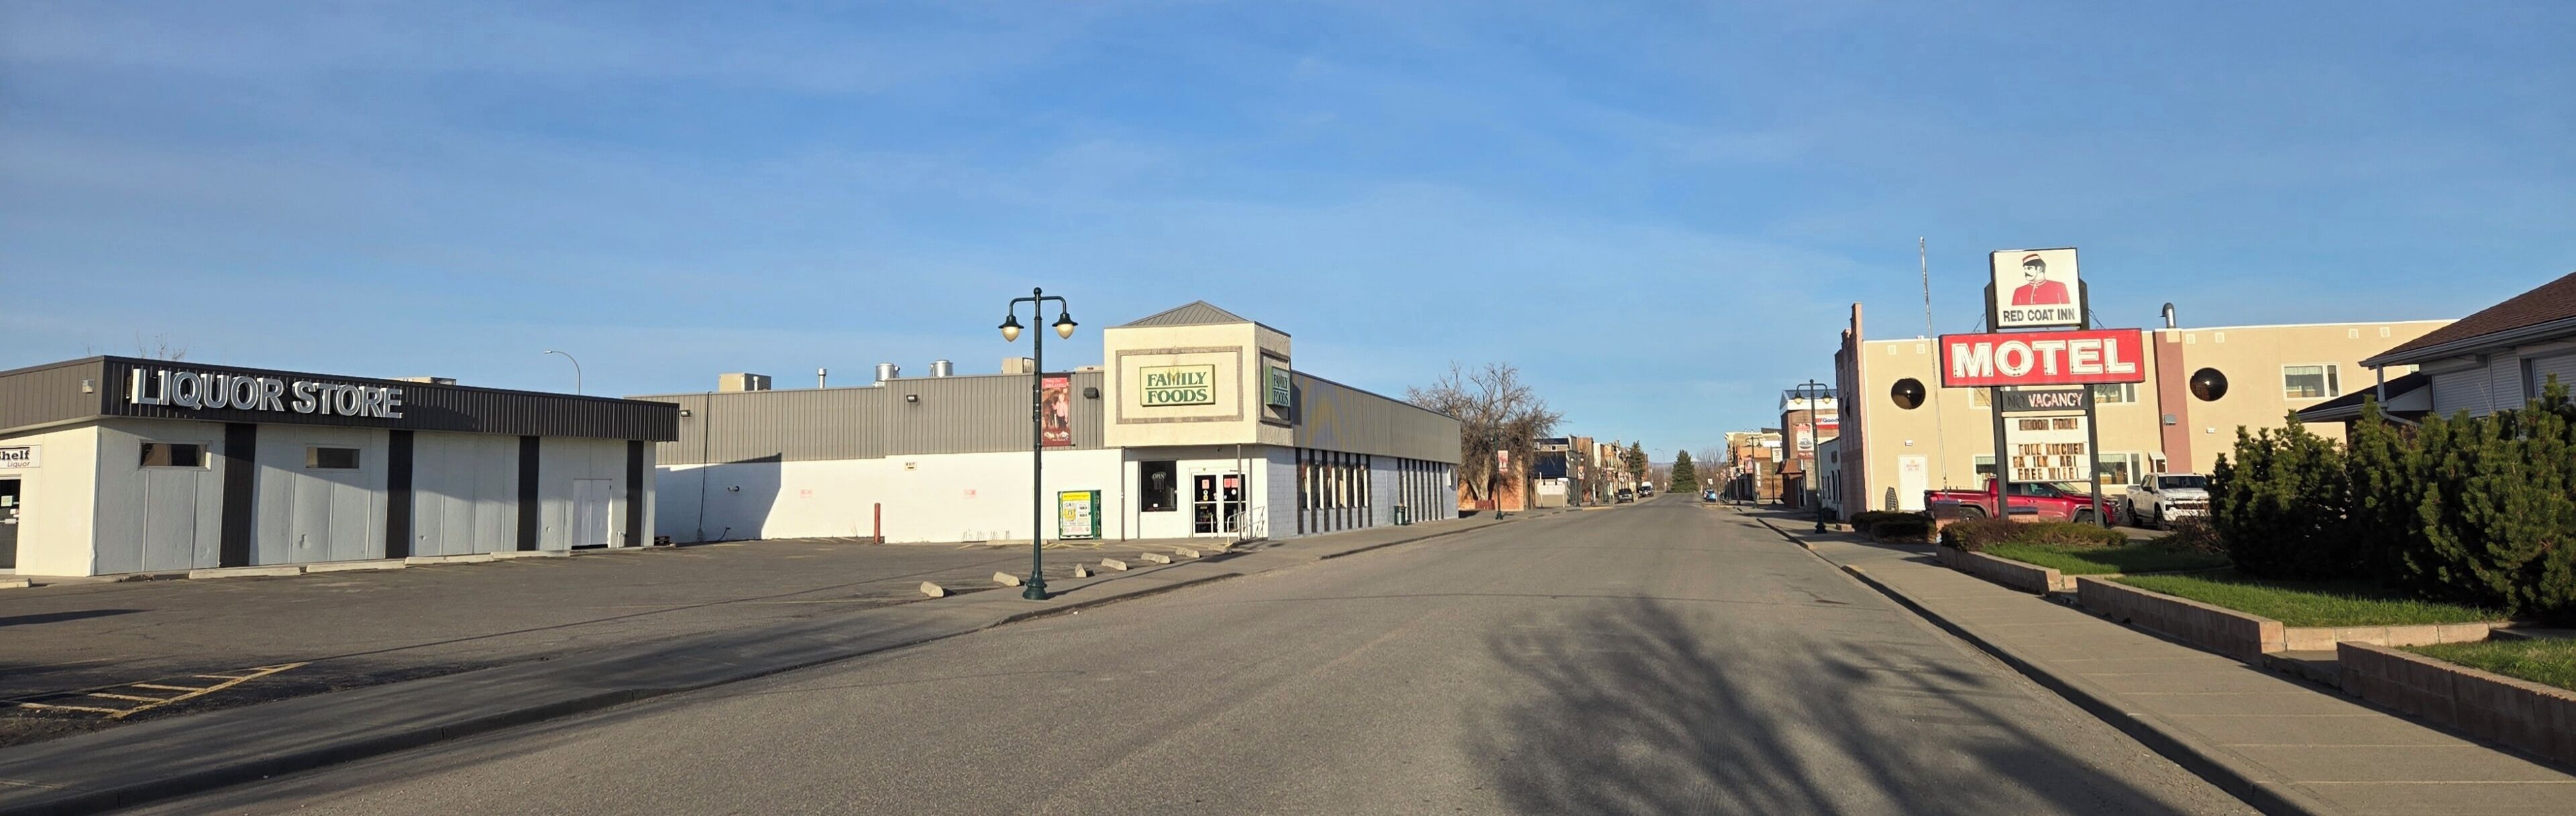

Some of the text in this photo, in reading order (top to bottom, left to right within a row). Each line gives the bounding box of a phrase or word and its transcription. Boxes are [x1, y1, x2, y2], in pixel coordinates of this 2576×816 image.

[2003, 308, 2075, 322] RED COAT INN
[1951, 339, 2136, 378] MOTEL
[1147, 368, 1207, 387] FAMILY
[1273, 373, 1287, 389] FAMILY
[131, 368, 402, 419] LIQUOR STORE
[1148, 389, 1208, 403] FOODS
[1273, 390, 1289, 405] FOODS
[2006, 392, 2083, 408] NO VACANCY
[0, 450, 30, 460] helf
[2019, 443, 2084, 455] FULL KITCHEN
[2018, 469, 2043, 480] FREE
